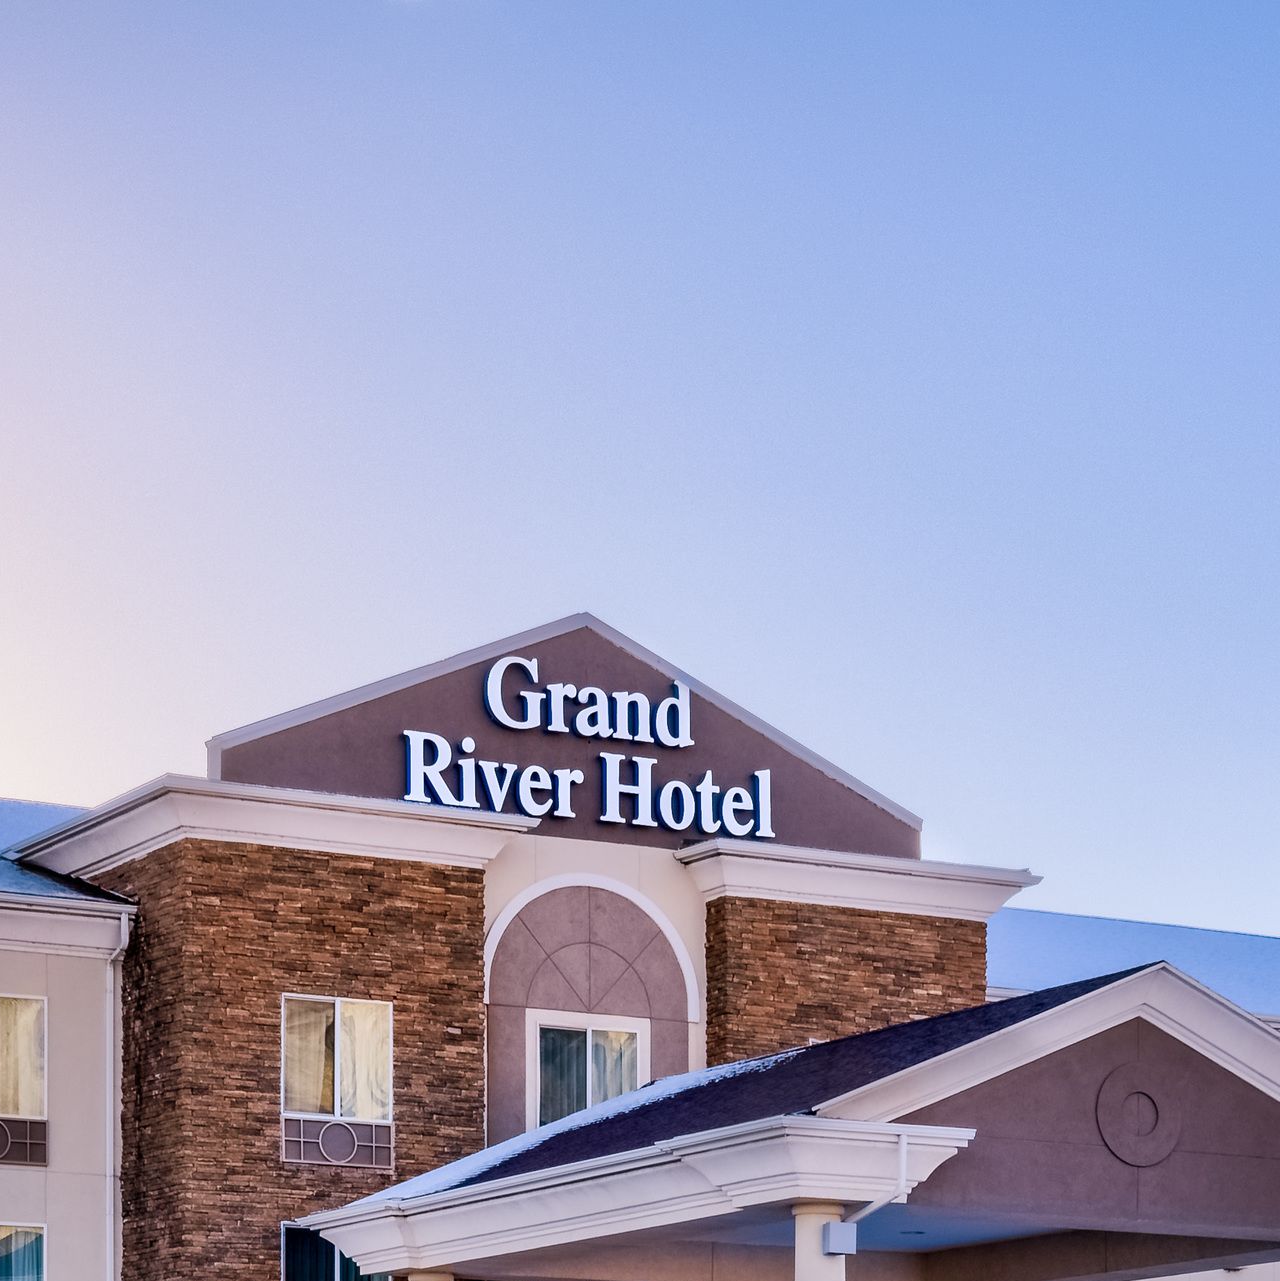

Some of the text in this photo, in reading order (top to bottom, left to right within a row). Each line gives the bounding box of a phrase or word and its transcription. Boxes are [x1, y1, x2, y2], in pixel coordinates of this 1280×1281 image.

[485, 656, 696, 748] Grand
[403, 729, 777, 838] River Hotel
